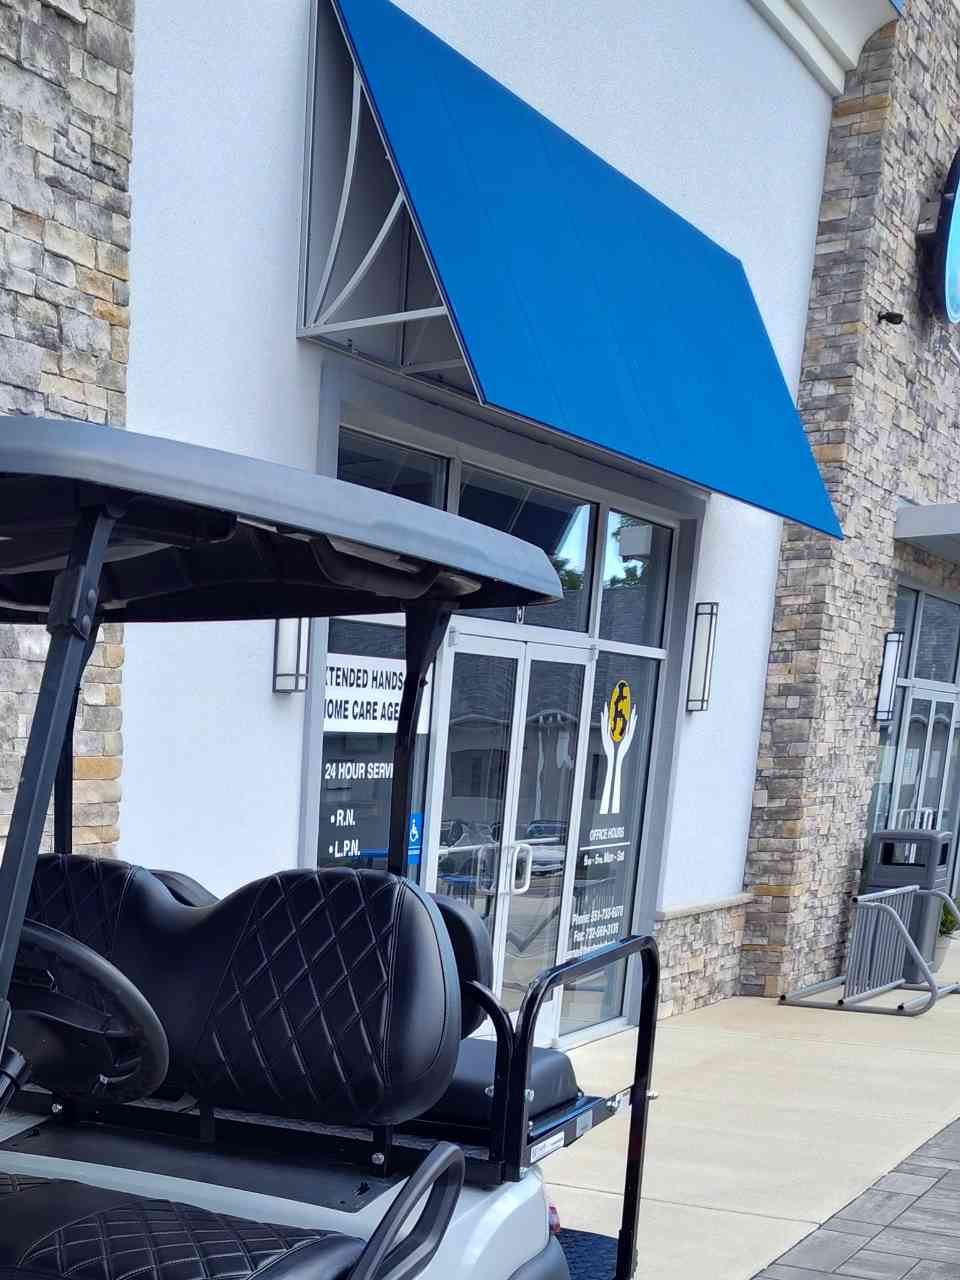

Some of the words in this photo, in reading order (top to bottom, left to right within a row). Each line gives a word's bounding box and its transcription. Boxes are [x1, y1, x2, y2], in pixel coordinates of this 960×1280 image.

[325, 666, 369, 689] TENDED
[371, 669, 403, 691] HANDS
[352, 699, 379, 721] CARE
[380, 701, 400, 721] AGE
[325, 762, 336, 779] 24
[338, 761, 366, 779] HOUR
[367, 762, 394, 779] SERVI
[336, 809, 356, 827] R.N.
[334, 839, 361, 858] L.P.N.
